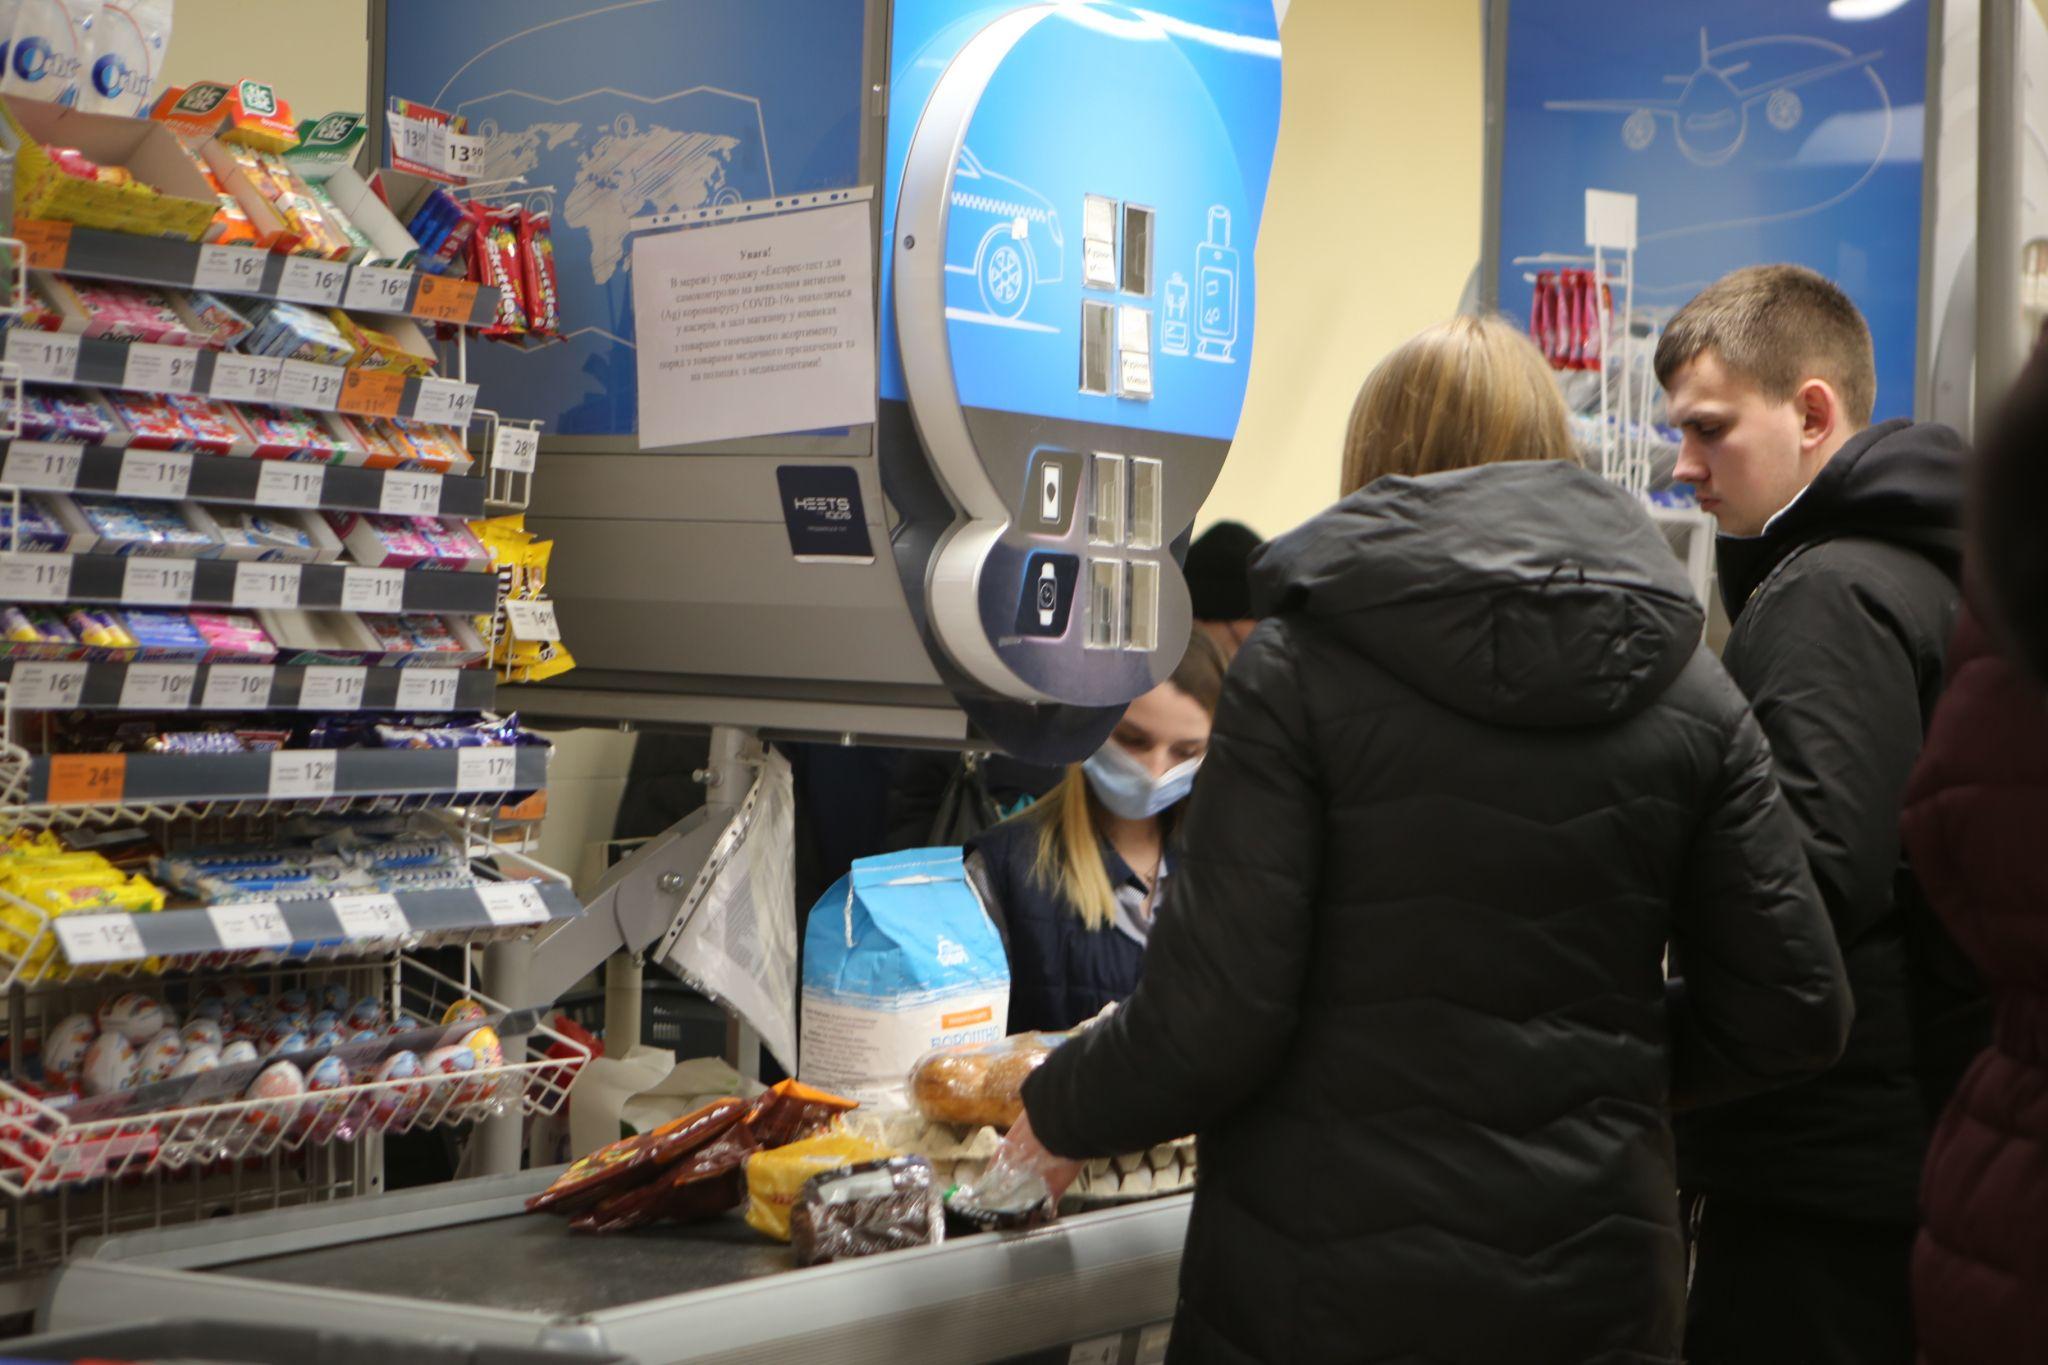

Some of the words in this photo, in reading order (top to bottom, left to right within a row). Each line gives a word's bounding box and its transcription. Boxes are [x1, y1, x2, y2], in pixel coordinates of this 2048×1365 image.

[449, 144, 470, 162] 13
[470, 144, 484, 155] 50
[740, 247, 771, 260] Увага!
[234, 258, 253, 275] 16
[314, 272, 333, 289] 16
[380, 279, 398, 296] 16
[43, 345, 64, 364] 11
[170, 358, 182, 376] 9
[247, 367, 267, 386] 13
[311, 376, 329, 394] 13
[447, 393, 465, 410] 14
[514, 439, 528, 456] 28
[44, 454, 65, 474] 11
[157, 463, 176, 482] 11
[293, 474, 310, 491] 11
[412, 484, 428, 501] 11
[794, 497, 851, 511] HEETS
[36, 565, 56, 585] 11
[162, 570, 180, 588] 11
[270, 575, 286, 592] 11
[375, 579, 391, 597] 11
[48, 673, 71, 692] 16
[160, 675, 181, 693] 10
[240, 676, 260, 694] 10
[335, 677, 353, 694] 11
[430, 678, 446, 696] 11
[304, 762, 324, 780] 12
[488, 758, 504, 775] 17
[87, 767, 110, 787] 24
